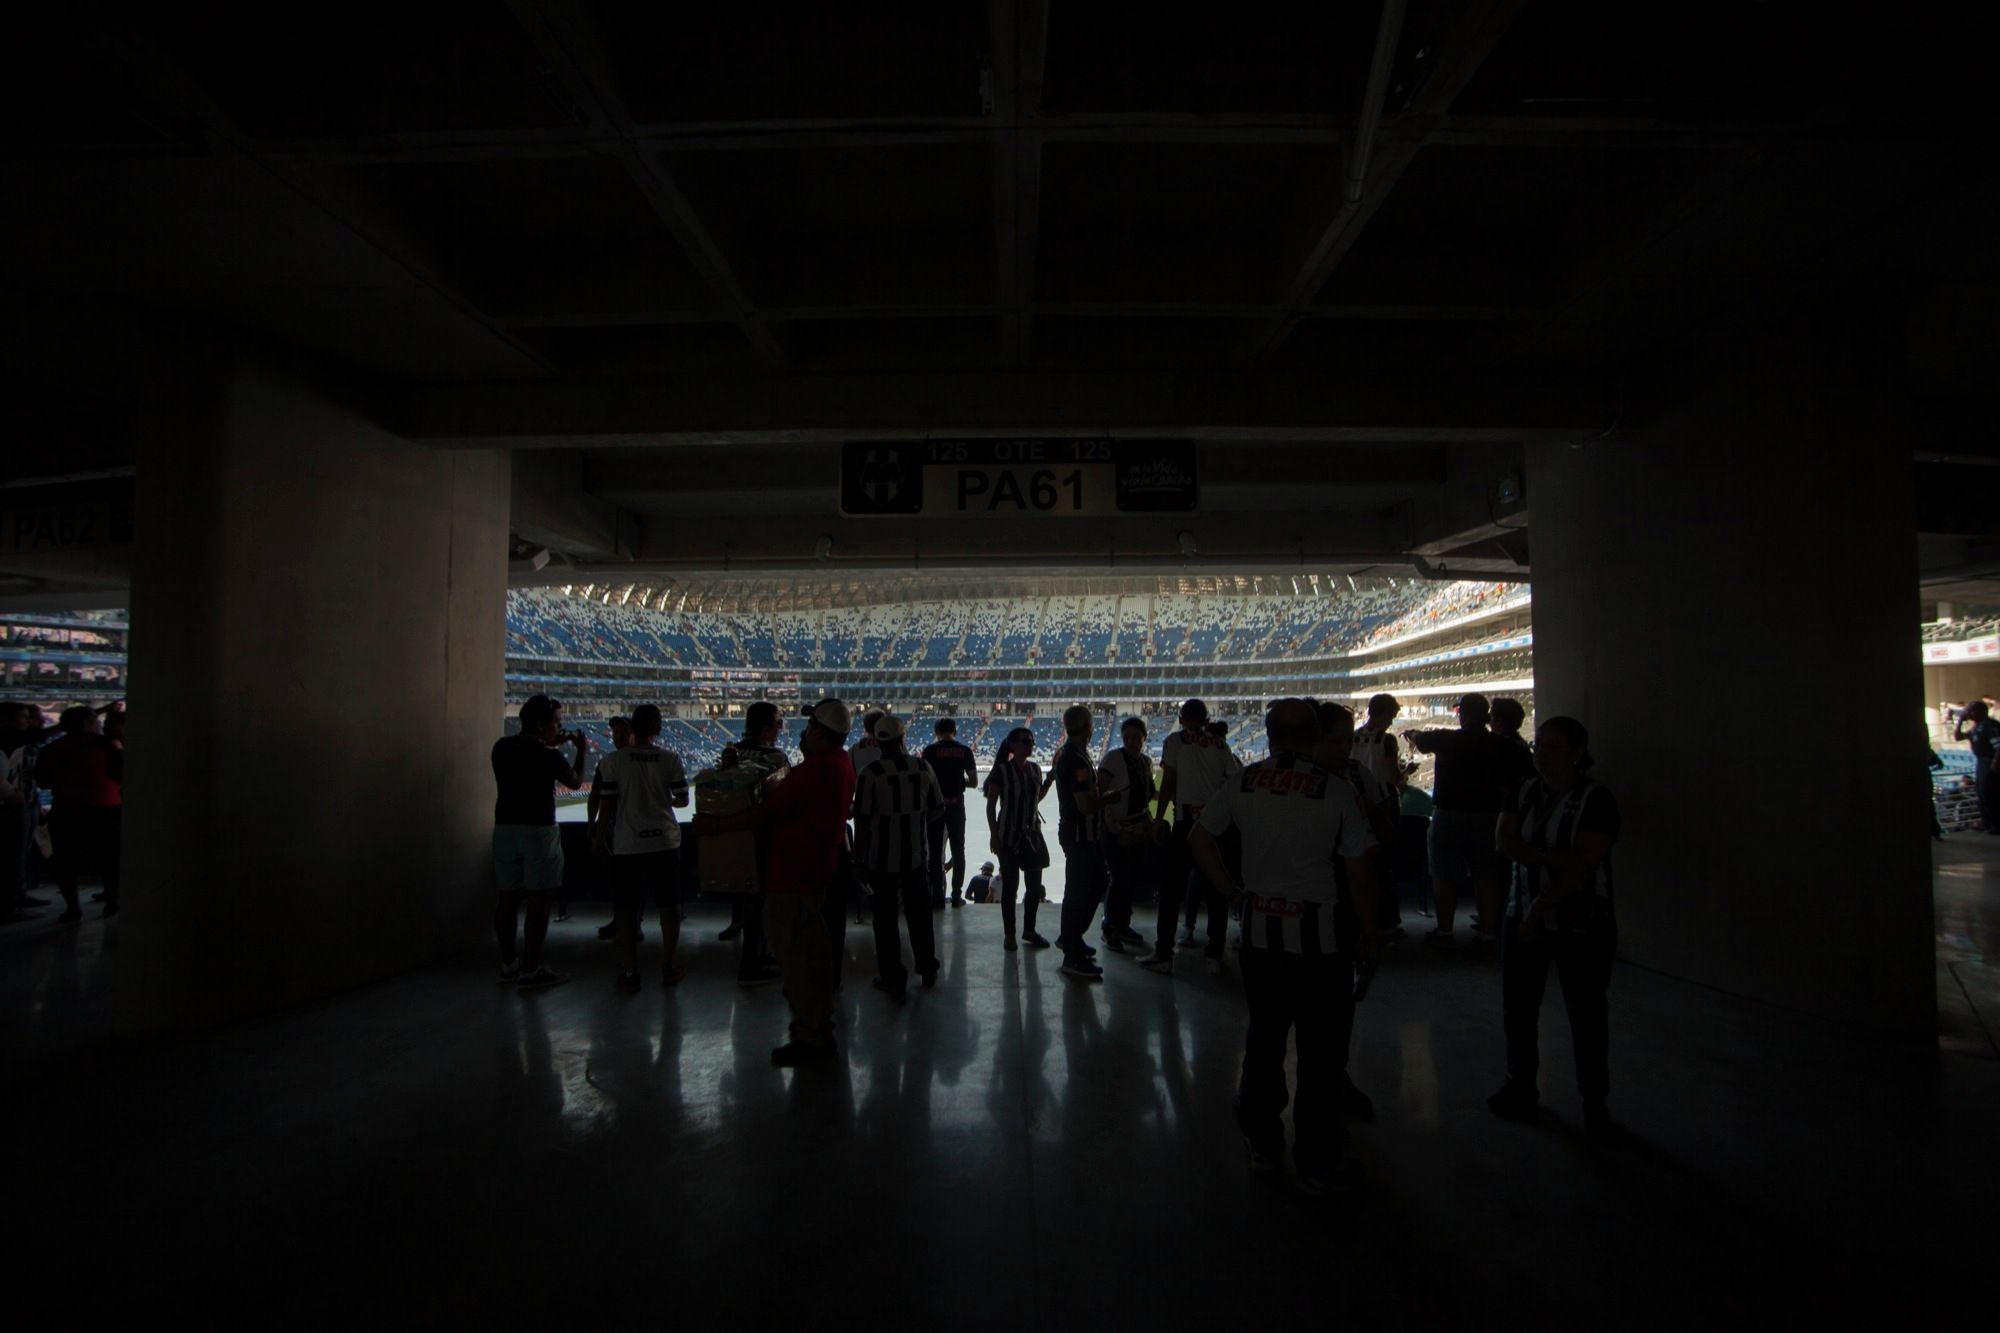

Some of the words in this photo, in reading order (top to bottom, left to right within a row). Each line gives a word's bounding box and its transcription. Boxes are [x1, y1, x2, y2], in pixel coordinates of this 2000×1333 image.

[928, 441, 969, 462] 125
[992, 441, 1043, 462] OTE
[1071, 441, 1112, 462] 125
[956, 469, 1084, 511] PA61
[15, 510, 95, 548] PA62
[1246, 767, 1323, 795] TECATE
